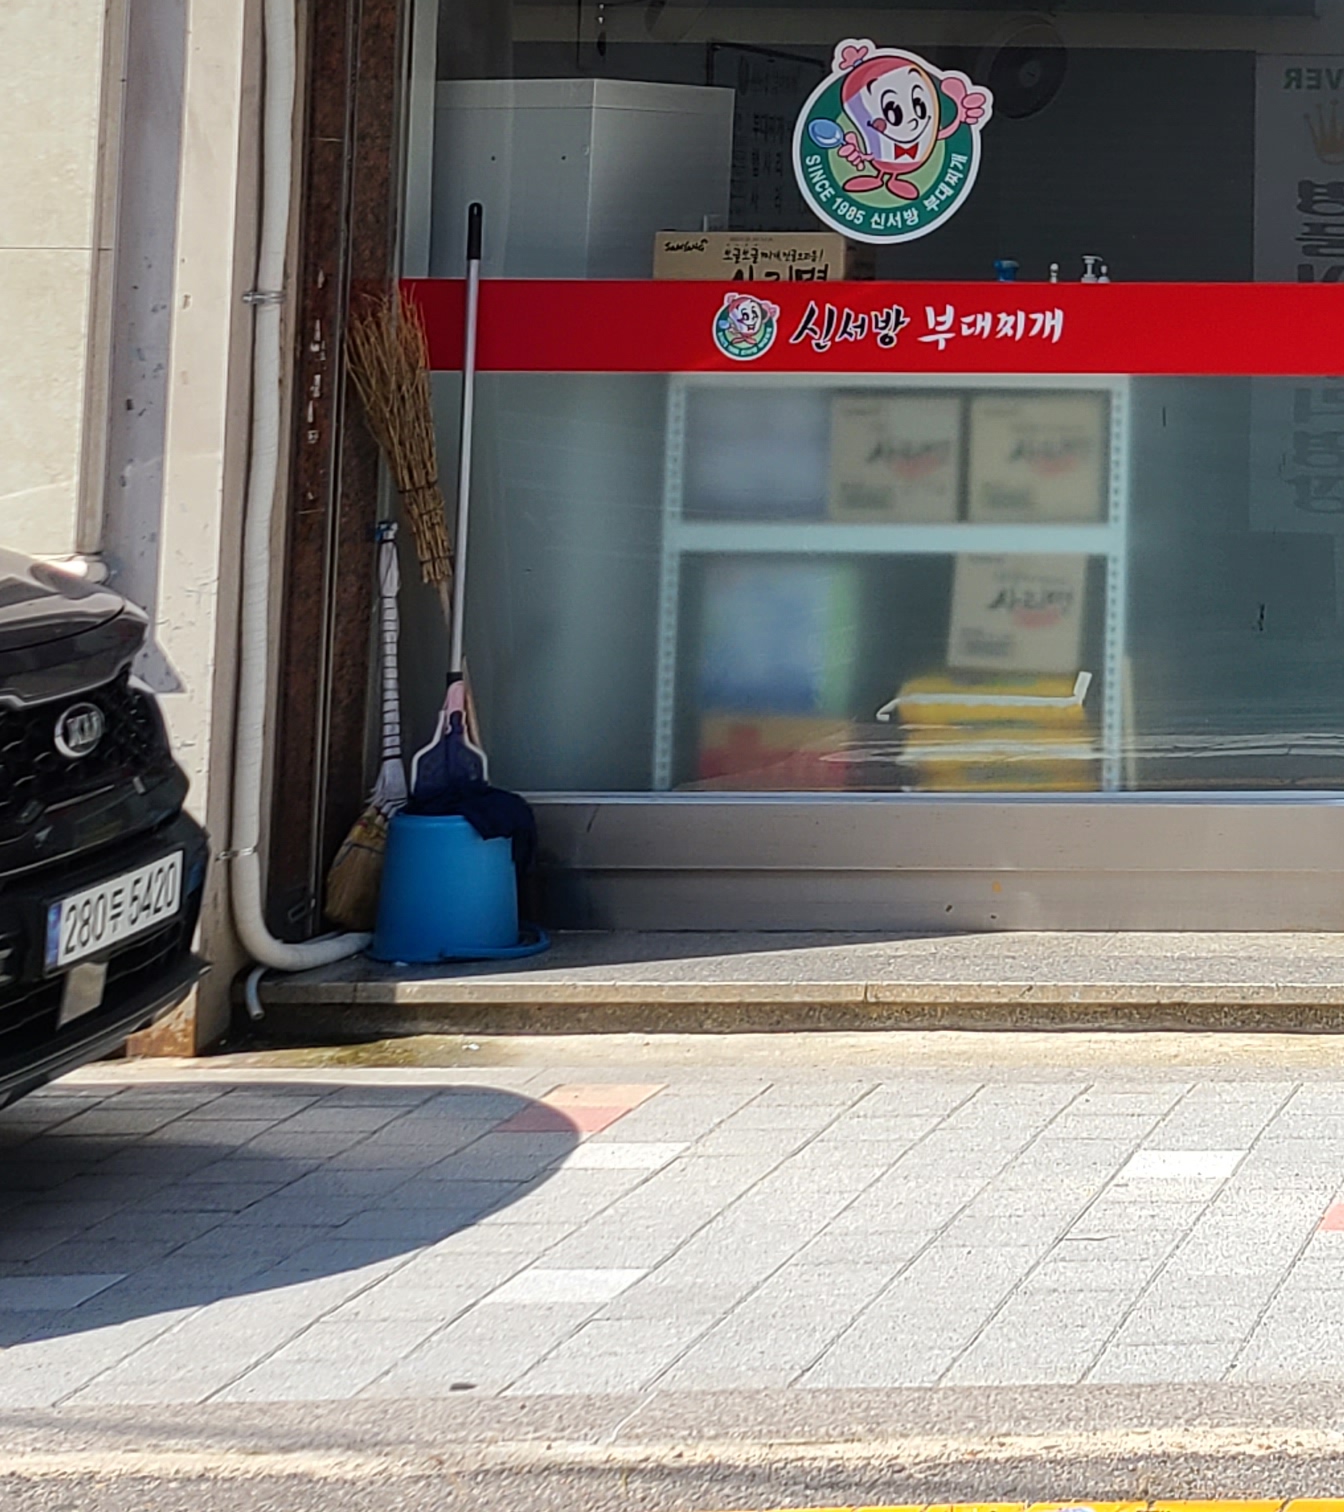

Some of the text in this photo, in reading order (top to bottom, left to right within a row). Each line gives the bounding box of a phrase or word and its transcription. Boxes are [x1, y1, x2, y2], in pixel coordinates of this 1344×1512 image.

[806, 154, 834, 202] SINCE
[832, 196, 866, 225] 1985
[870, 208, 919, 230] 신서방
[923, 153, 968, 212] 부대찌개
[789, 300, 910, 352] 신서방
[917, 305, 1064, 351] 부대찌개
[129, 861, 177, 926] 5420
